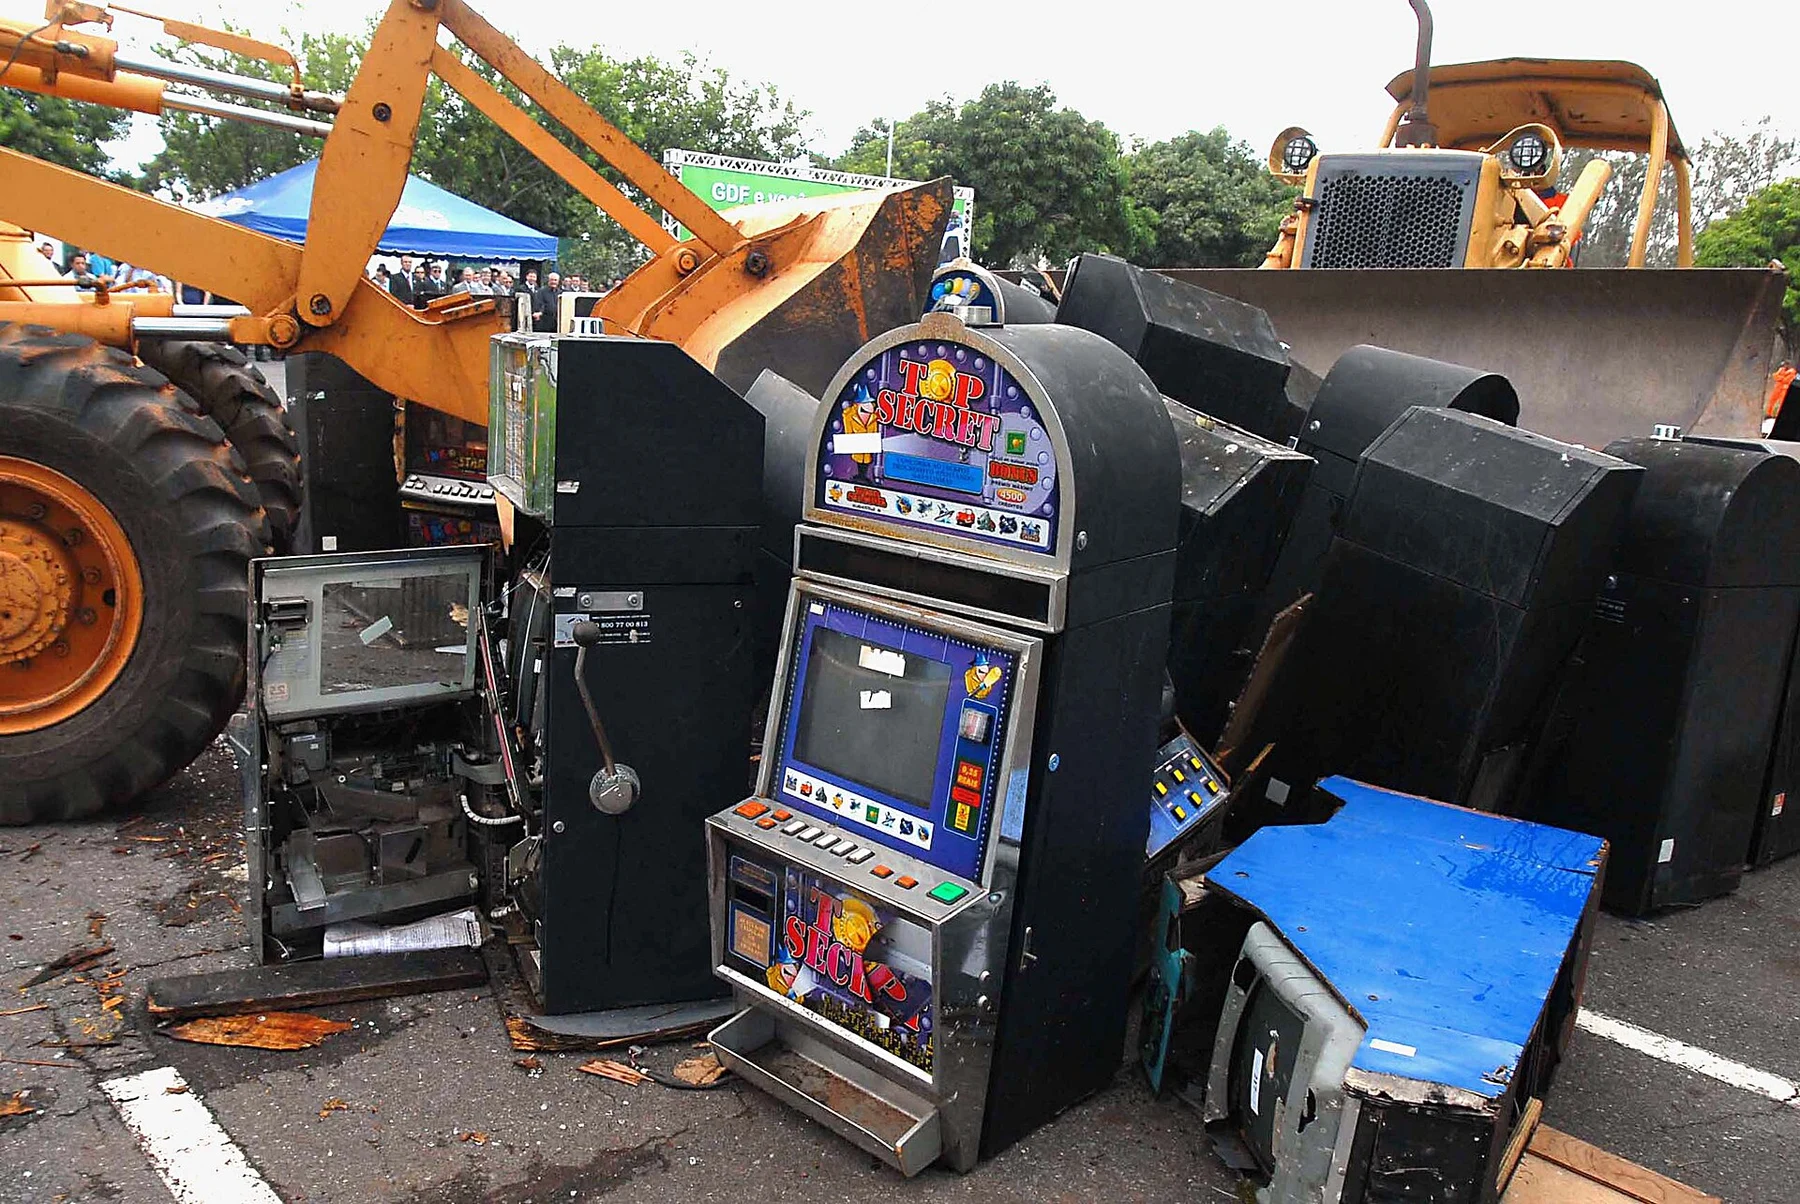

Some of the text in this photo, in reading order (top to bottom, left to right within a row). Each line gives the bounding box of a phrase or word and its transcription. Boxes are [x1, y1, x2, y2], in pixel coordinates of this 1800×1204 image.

[711, 182, 750, 203] GDF
[753, 191, 765, 204] e
[899, 359, 984, 409] TOP
[877, 389, 1000, 450] SECRET
[990, 461, 1038, 484] BONUS
[1000, 490, 1023, 502] 4500
